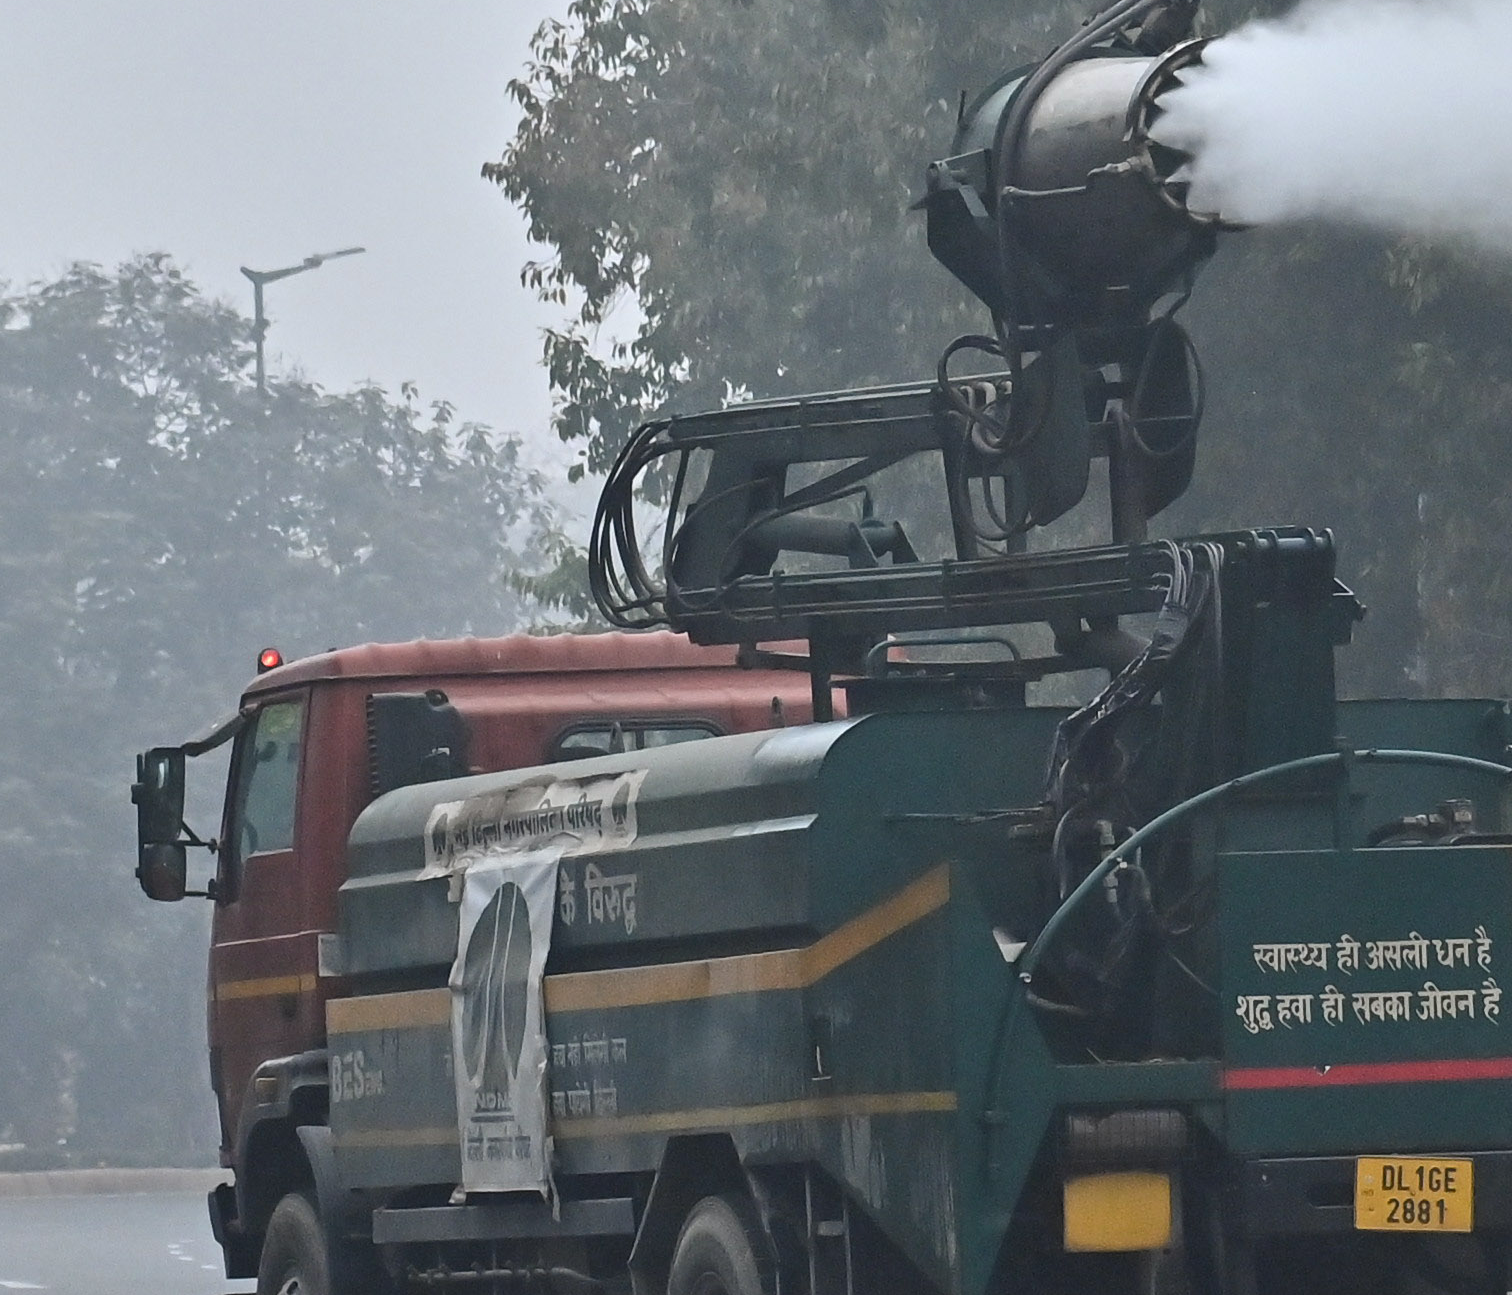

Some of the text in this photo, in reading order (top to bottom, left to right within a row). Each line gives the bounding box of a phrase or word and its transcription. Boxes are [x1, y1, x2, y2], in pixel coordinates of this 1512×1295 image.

[560, 867, 575, 925] के
[1253, 925, 1492, 976] स्वास्थ्य ही असली धन है
[1236, 977, 1502, 1034] शुद्ध हवा ही सबका जीवन है
[1382, 1165, 1457, 1193] DL1GE
[1387, 1198, 1445, 1224] 2881
